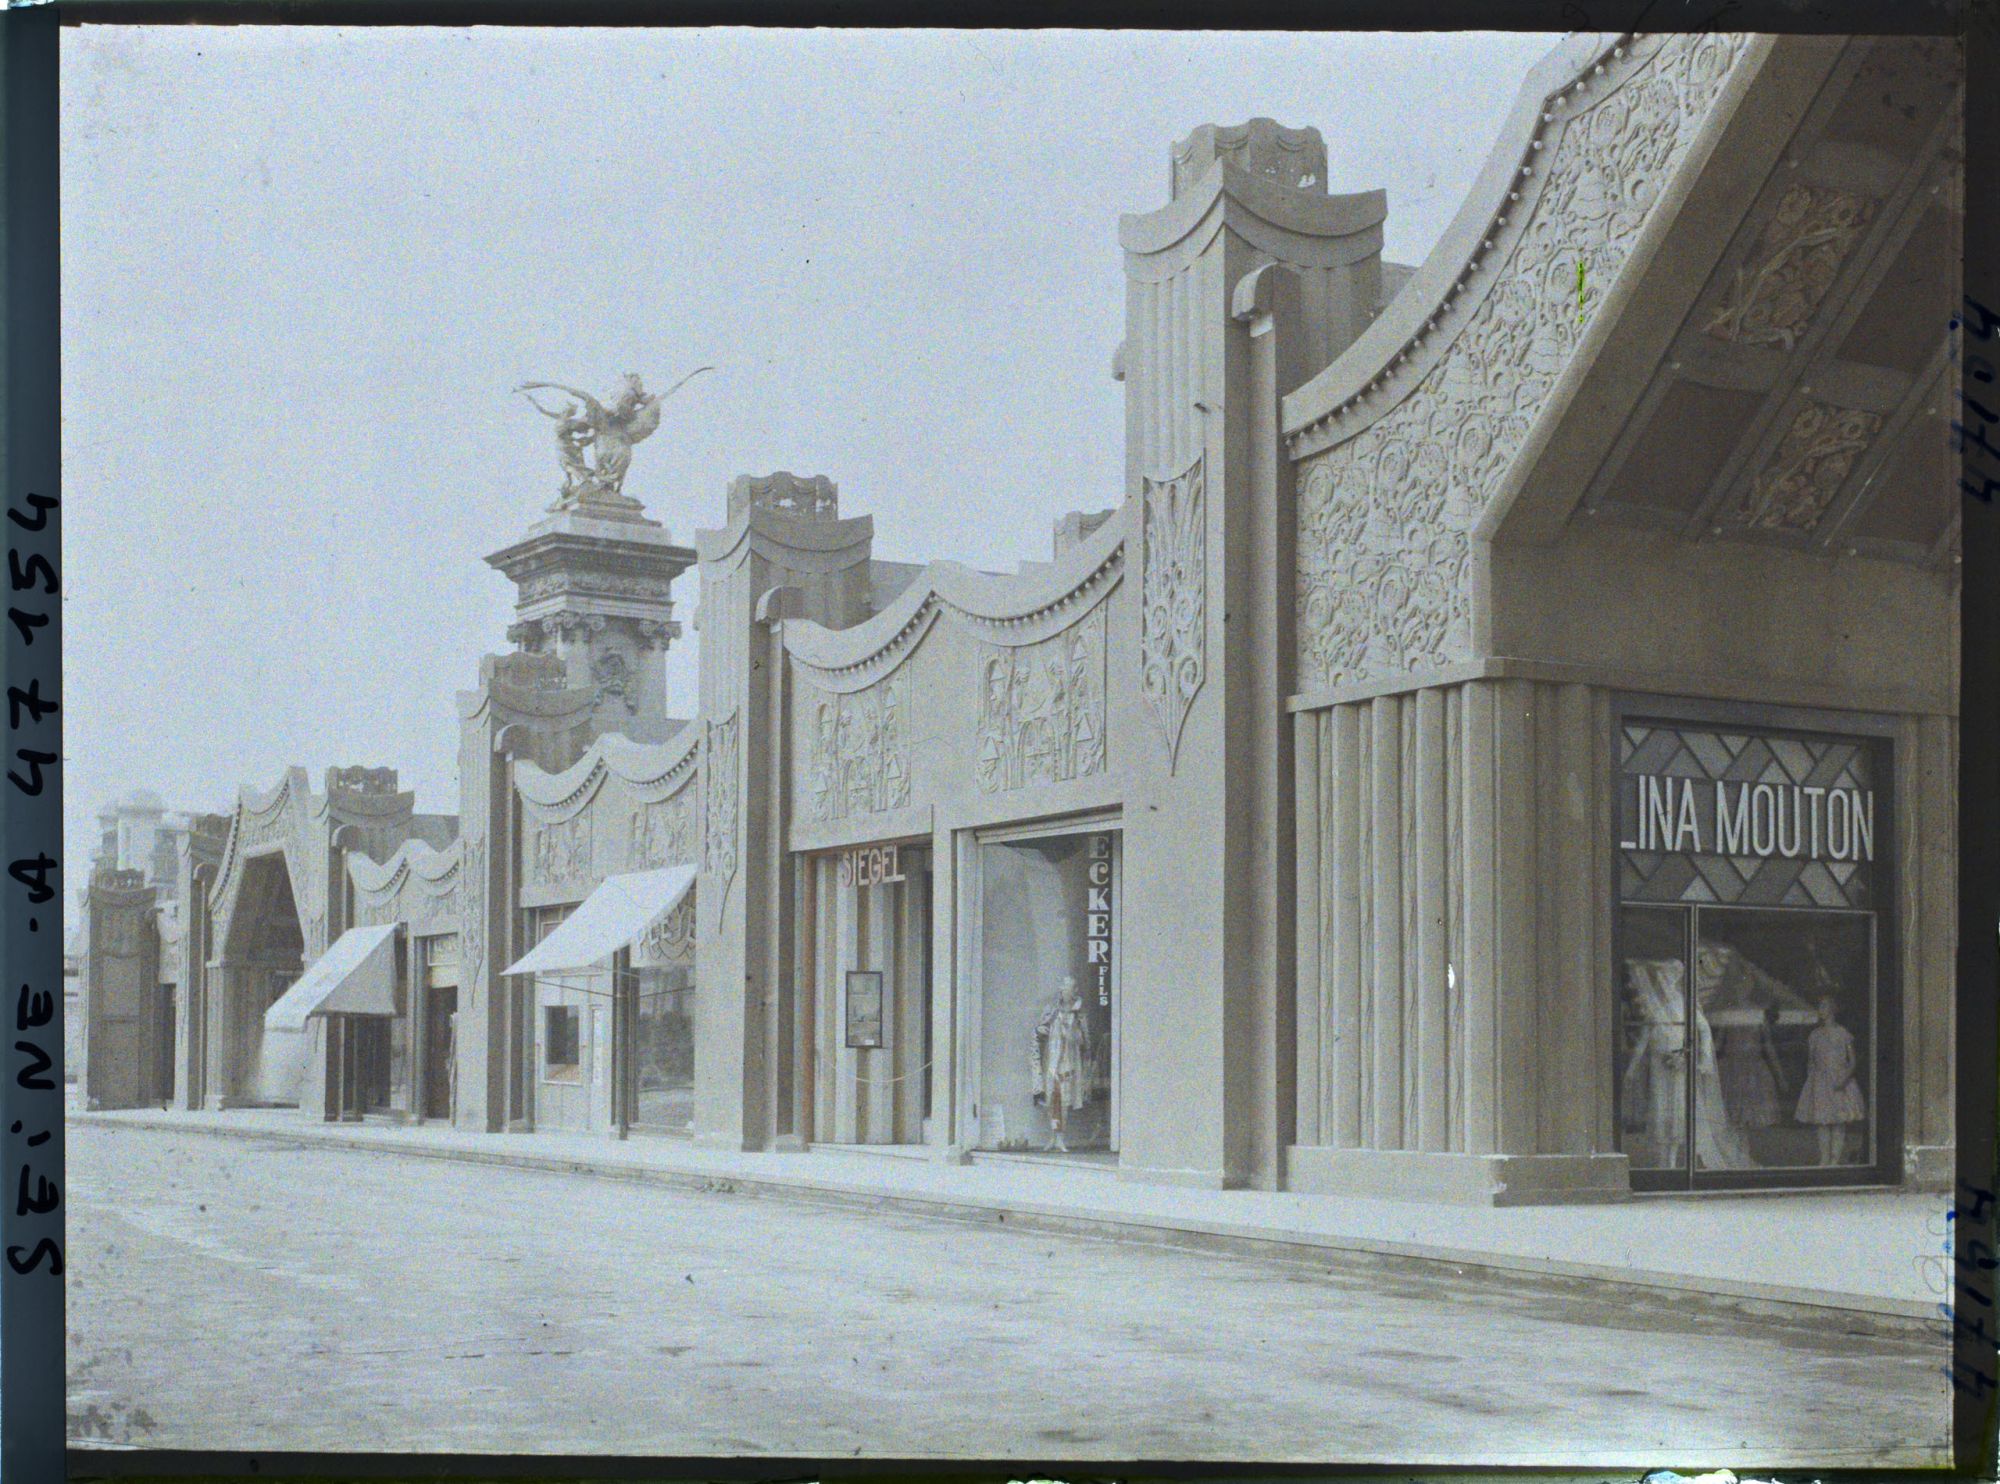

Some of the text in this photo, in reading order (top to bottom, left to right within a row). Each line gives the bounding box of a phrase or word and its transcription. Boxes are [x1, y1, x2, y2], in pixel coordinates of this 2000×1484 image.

[7, 492, 59, 797] 47154
[1620, 775, 1873, 861] INA MOUTON
[841, 844, 906, 889] SIEGEL
[1098, 965, 1109, 1007] FILS
